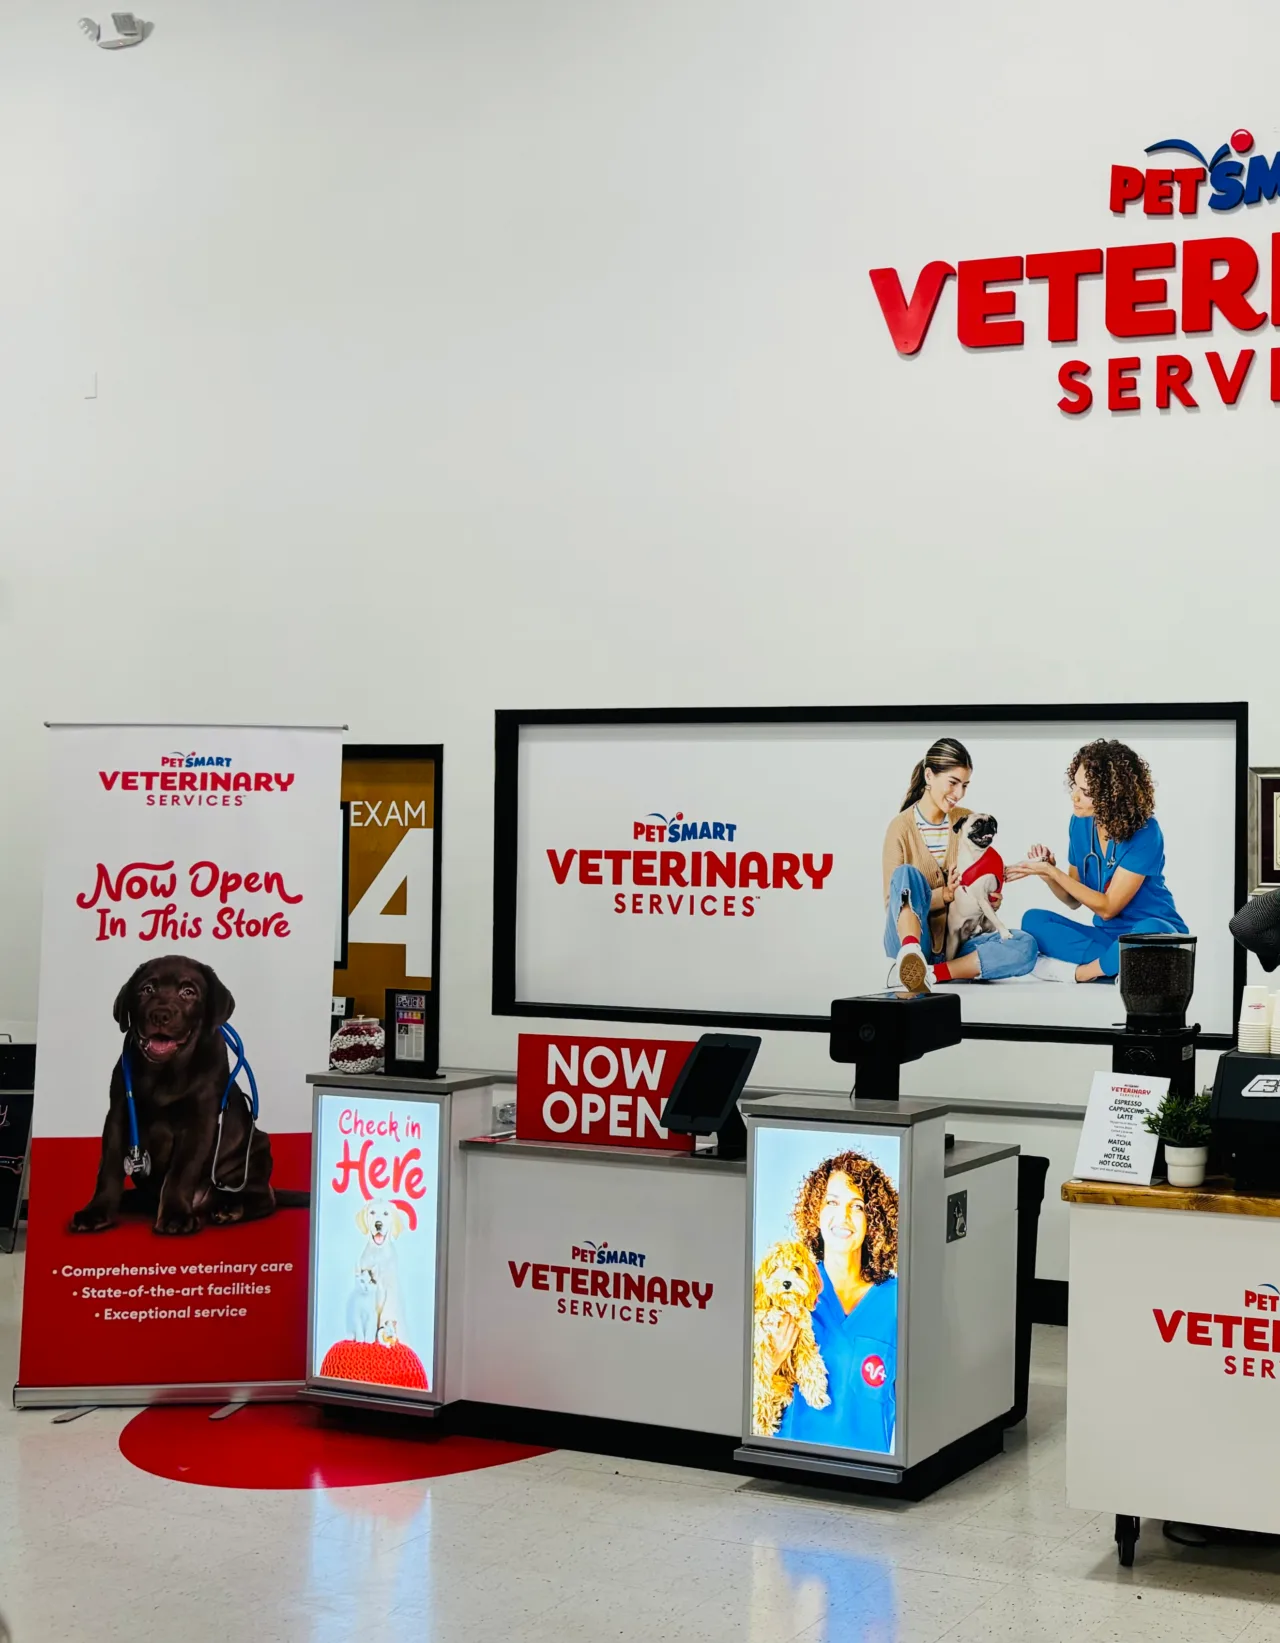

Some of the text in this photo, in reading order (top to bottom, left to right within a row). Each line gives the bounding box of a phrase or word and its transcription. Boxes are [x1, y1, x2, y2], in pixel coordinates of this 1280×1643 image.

[161, 752, 232, 768] PETSMART
[99, 770, 295, 793] VETERINARY
[146, 794, 244, 807] SERVICES
[350, 801, 425, 827] EXAM
[633, 812, 737, 842] PETSMART
[546, 848, 834, 890] VETERINARY
[76, 860, 303, 908] Now Open
[348, 828, 434, 978] 4
[614, 893, 755, 917] SERVICES
[96, 903, 291, 941] In This Store
[547, 1044, 667, 1091] NOW
[1111, 1086, 1151, 1095] VETERINARY
[1114, 1099, 1142, 1107] ESPRESSO
[542, 1091, 669, 1140] OPEN
[1109, 1105, 1145, 1114] CAPPUCCINO
[338, 1108, 422, 1140] Check in
[1108, 1138, 1131, 1146] MATCHA
[332, 1139, 427, 1230] Here
[571, 1241, 646, 1267] PETSMART
[61, 1261, 293, 1278] Comprehensive veterinary care
[81, 1283, 271, 1299] State-of-the-art facilities
[508, 1260, 714, 1309] VETERINARY
[104, 1306, 247, 1322] Exceptional service
[557, 1298, 659, 1325] SERVICES
